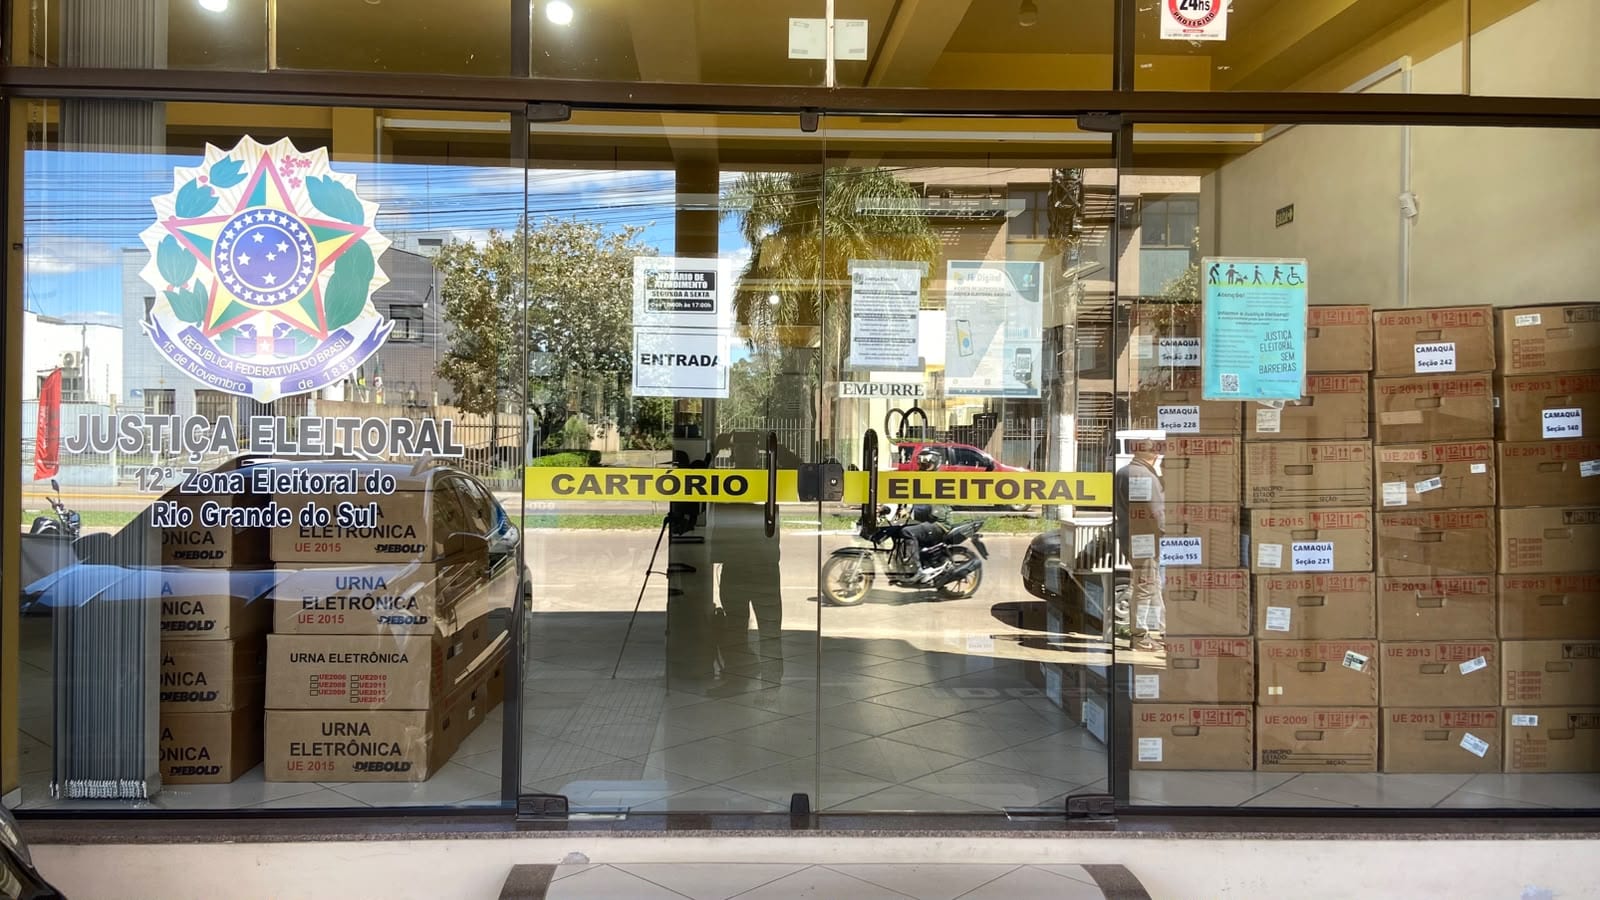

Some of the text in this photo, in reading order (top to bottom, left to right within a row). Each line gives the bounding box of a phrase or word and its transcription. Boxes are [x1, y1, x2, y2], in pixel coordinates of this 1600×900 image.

[694, 273, 705, 281] DE
[1380, 316, 1423, 326] UE 2013
[1259, 341, 1295, 352] ELEITORAL
[1416, 345, 1454, 353] CAMAQUÃ
[235, 362, 301, 376] FEDERATIVA
[301, 357, 317, 369] DO
[317, 337, 351, 362] BRASIL
[1280, 352, 1295, 362] SEM
[163, 341, 246, 391] 15 de Novembro
[1258, 362, 1297, 374] BARREIRAS
[298, 379, 314, 390] de
[1381, 385, 1398, 394] UE
[1511, 381, 1551, 391] UE 2013
[843, 383, 925, 397] EMPURRE
[1159, 406, 1198, 415] CAMAQUÃ
[1543, 410, 1580, 419] CAMAQUÃ
[1161, 421, 1180, 429] Seção
[65, 415, 239, 463] JUSTIÇA
[250, 416, 465, 457] ELEITORAL
[1130, 443, 1146, 452] UE
[1505, 447, 1519, 456] UE
[1384, 451, 1428, 460] UE 2015
[135, 467, 396, 495] 12ª Zona Eleitoral do
[551, 470, 1097, 501] CARTÓRIO ELEITORAL
[152, 501, 194, 527] Rio
[200, 501, 292, 528] Grande
[299, 502, 330, 528] do
[337, 502, 377, 528] Sul
[1130, 509, 1146, 520] UE
[1260, 517, 1304, 527] UE 2015
[1381, 517, 1398, 527] UE
[295, 543, 342, 552] UE 2015
[1160, 538, 1200, 547] CAMAQUÃ
[374, 544, 426, 553] DIEBOLD
[1293, 544, 1332, 552] CAMAQUÃ
[174, 550, 225, 560] DIEBOLD
[1162, 553, 1184, 561] Seção
[1295, 558, 1316, 566] Seção
[336, 576, 387, 590] URNA
[1267, 579, 1311, 590] UE 2015
[1384, 582, 1426, 592] UE 2013
[1505, 579, 1519, 589] UE
[302, 593, 420, 610] ELETRÔNICA
[298, 614, 345, 624] UE 2015
[377, 615, 428, 625] DIEBOLD
[290, 651, 409, 664] URNA ELETRÔNICA
[1268, 648, 1284, 657] UE
[1387, 648, 1431, 657] UE 2013
[1141, 712, 1185, 722] UE 2015
[1264, 715, 1308, 725] UE 2009
[1393, 714, 1435, 723] UE 2013
[322, 722, 371, 737] URNA
[290, 739, 402, 756] ELETRÔNICA
[169, 765, 221, 776] DIEBOLD
[287, 761, 335, 771] UE 2015
[353, 761, 412, 772] DIEBOLD
